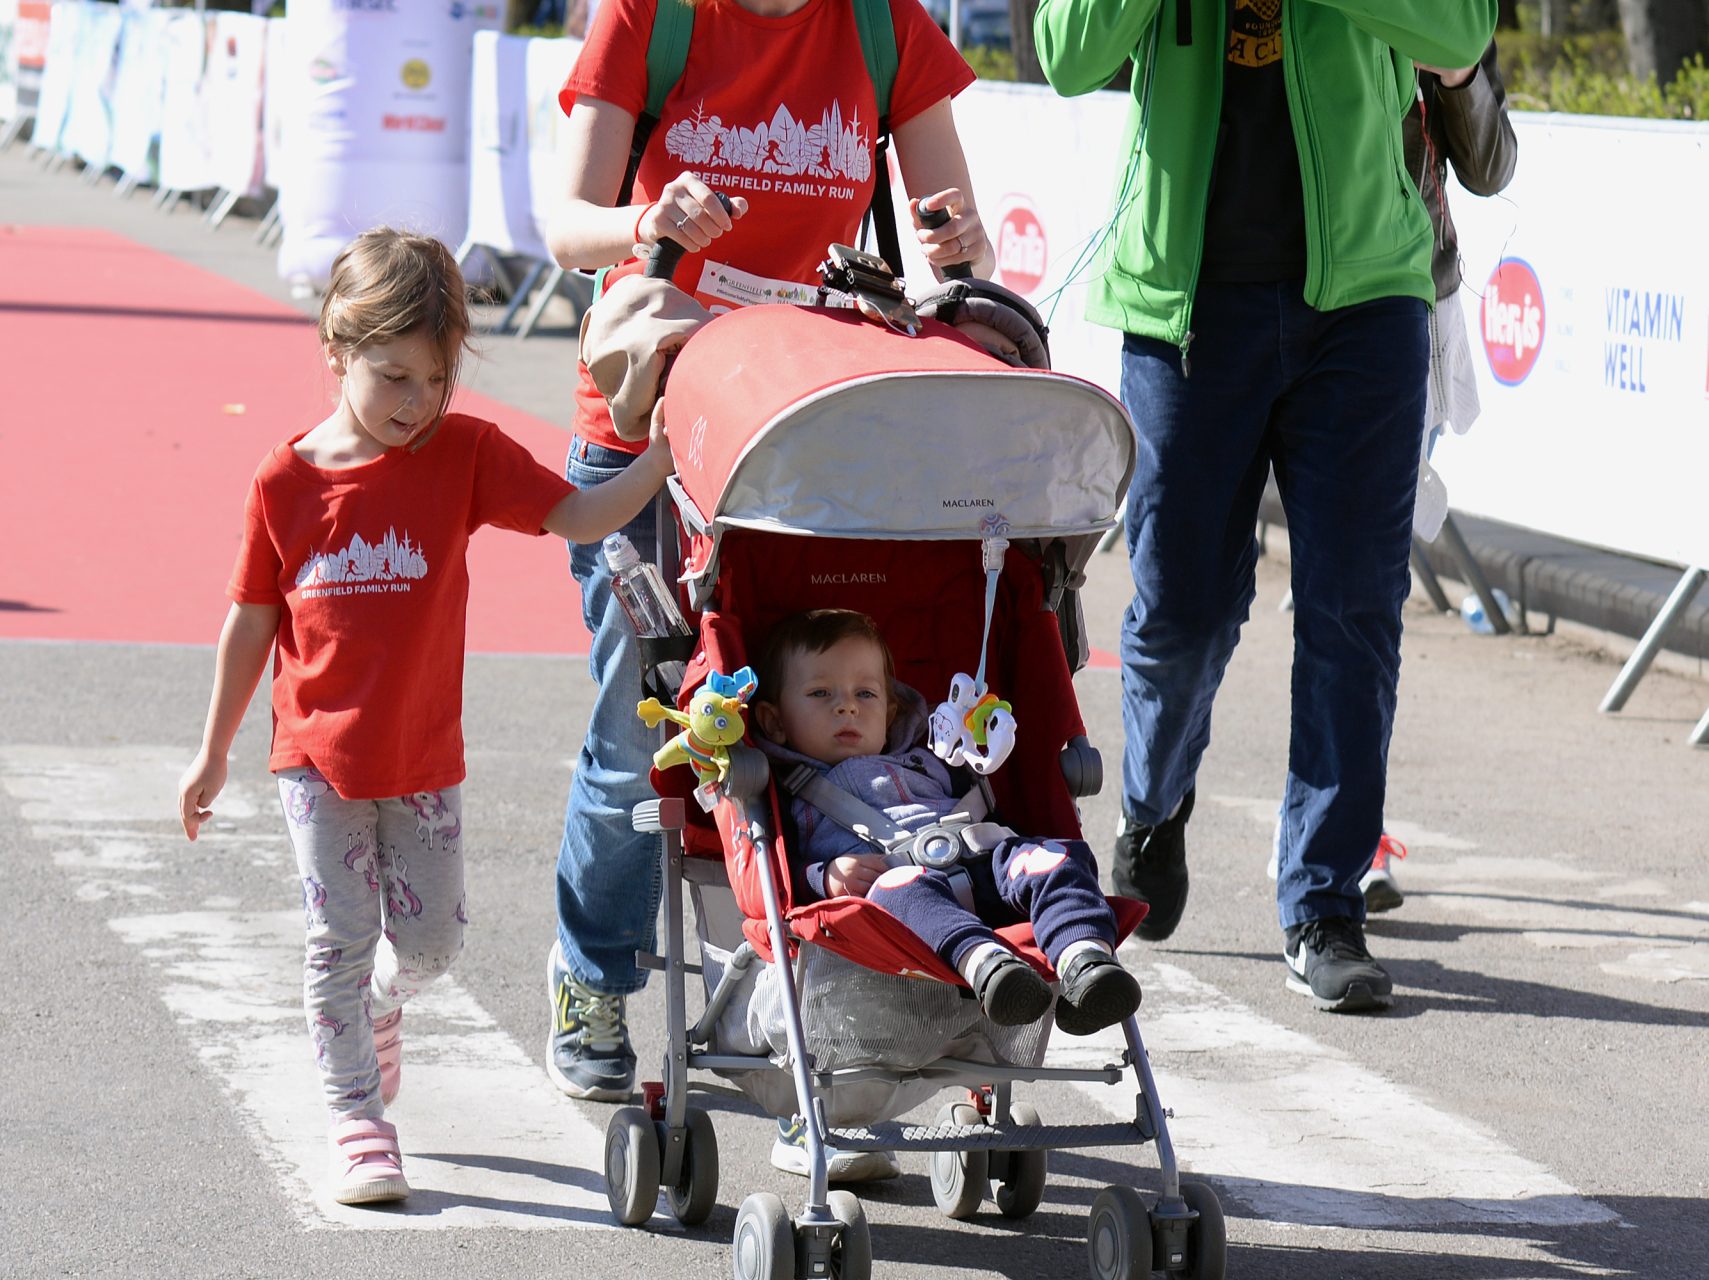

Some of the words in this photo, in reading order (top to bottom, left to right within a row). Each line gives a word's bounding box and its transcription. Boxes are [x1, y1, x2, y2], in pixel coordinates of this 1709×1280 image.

[774, 180, 824, 196] FAMILY
[828, 186, 855, 200] RUN
[1605, 287, 1684, 342] VITAMIN
[1604, 341, 1646, 393] WELL
[942, 498, 995, 509] MACLAREN
[810, 573, 888, 586] MACLAREN
[301, 586, 353, 599] GREENFIELD
[354, 584, 389, 594] FAMILY
[390, 582, 411, 592] RUN
